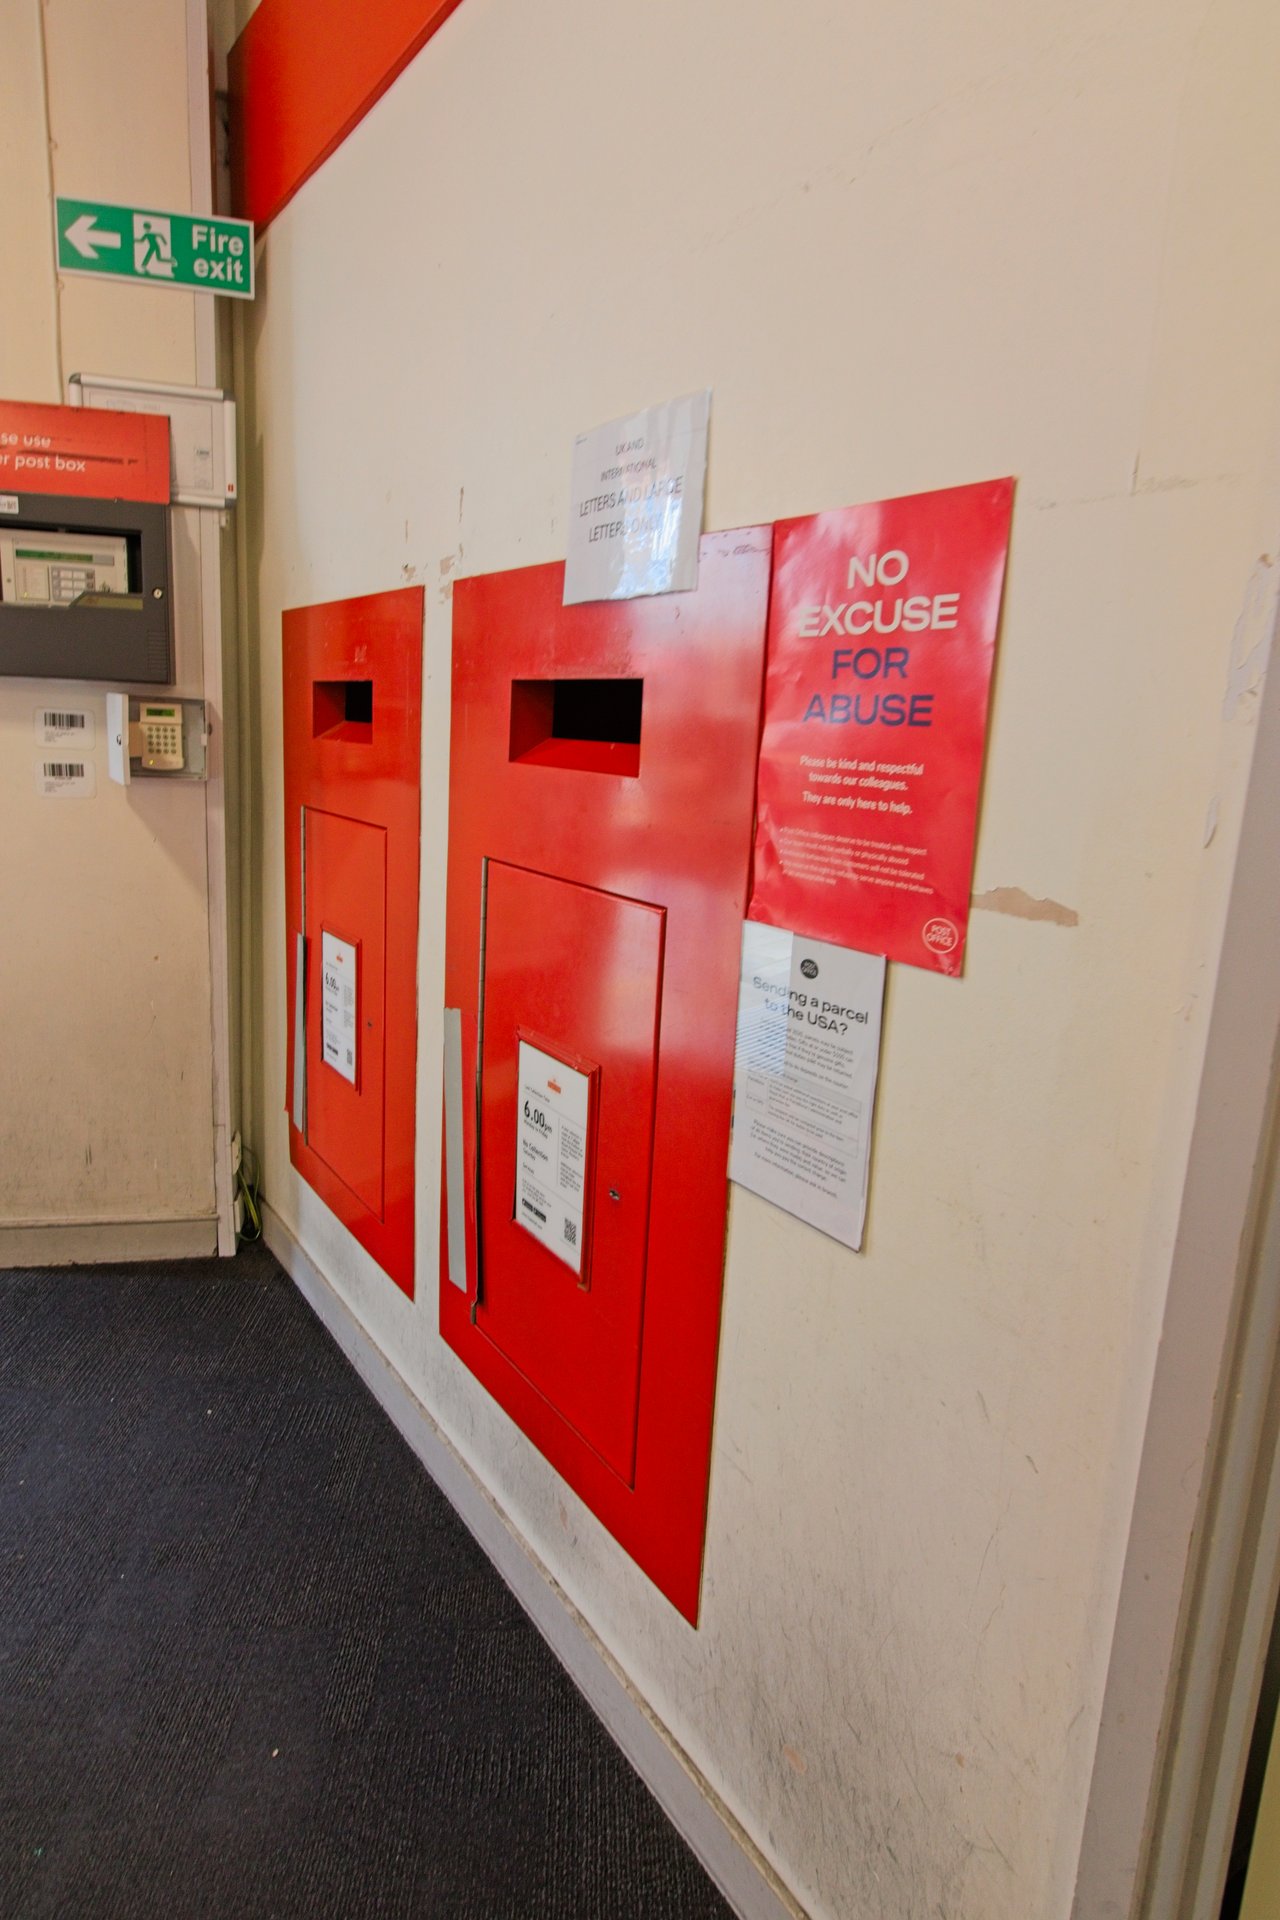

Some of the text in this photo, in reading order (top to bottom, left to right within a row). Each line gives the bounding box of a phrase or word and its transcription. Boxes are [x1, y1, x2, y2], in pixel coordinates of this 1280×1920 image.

[192, 224, 244, 256] Fire
[194, 258, 244, 284] exit
[24, 435, 51, 448] use
[15, 455, 50, 470] post
[55, 454, 86, 472] box
[579, 492, 616, 518] LETTERS
[847, 550, 910, 589] NO
[798, 593, 960, 638] EXCUSE
[831, 647, 910, 680] FOR
[803, 693, 935, 727] ABUSE
[800, 755, 925, 776] Please be kind and respectful
[809, 772, 909, 792] towards our colleagues.
[802, 790, 913, 816] They are only here to help.
[926, 933, 952, 946] OFFICE
[931, 924, 951, 938] POST
[764, 998, 778, 1011] to
[782, 1003, 804, 1021] the
[807, 1011, 848, 1036] USA?
[810, 997, 818, 1008] a
[822, 1001, 869, 1025] parcel
